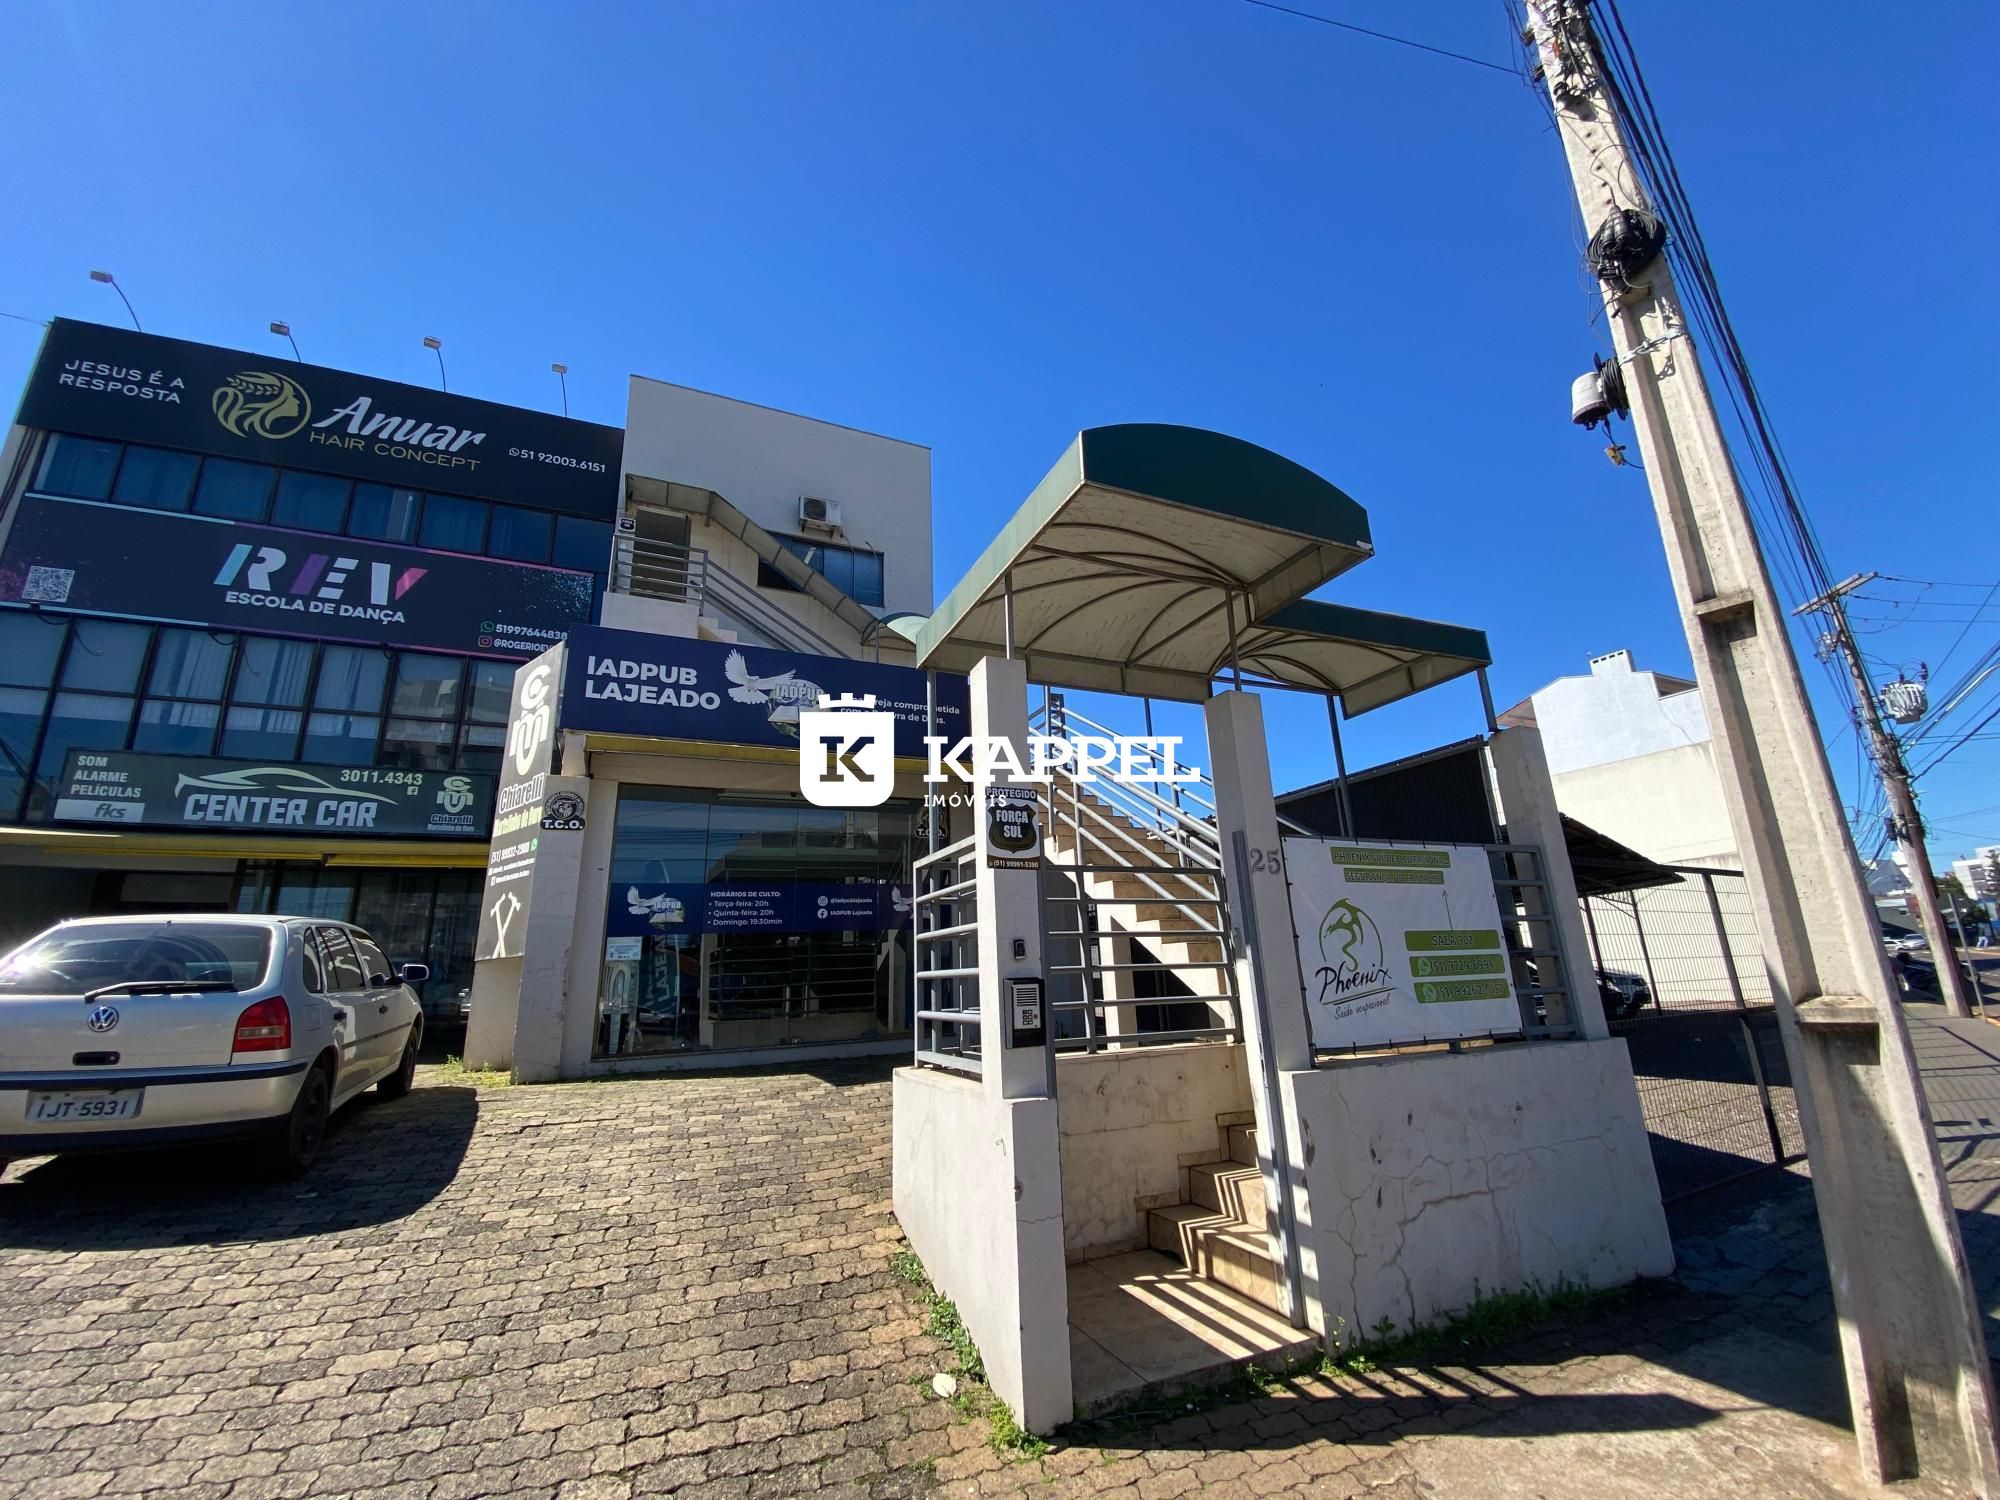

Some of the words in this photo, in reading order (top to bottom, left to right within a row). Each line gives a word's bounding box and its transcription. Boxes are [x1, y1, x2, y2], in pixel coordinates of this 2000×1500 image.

[65, 360, 143, 381] JESUS
[149, 370, 164, 385] É
[170, 377, 185, 389] A
[59, 373, 181, 404] RESPOSTA
[312, 396, 487, 453] Anuar
[310, 431, 365, 451] HAIR
[374, 443, 481, 472] CONCEPT
[520, 449, 534, 460] 51
[537, 452, 606, 473] 92003.6151
[213, 543, 428, 606] REV
[225, 590, 305, 612] ESCOLA
[309, 601, 335, 615] DE
[339, 605, 406, 625] DANÇA
[493, 639, 554, 652] @ROGERIOEV
[587, 655, 698, 686] IADPUB
[585, 680, 721, 710] LAJEADO
[894, 701, 960, 714] comproetida
[908, 713, 920, 721] de
[78, 755, 108, 767] SOM
[73, 770, 129, 783] ALARME
[340, 770, 423, 786] 3011.4343
[70, 784, 142, 798] PELÍCULAS
[498, 772, 546, 815] Chiarelli
[986, 787, 1037, 799] PROTEGIDO
[94, 803, 127, 819] fks
[183, 793, 309, 825] CENTER
[315, 800, 378, 828] CAR
[995, 809, 1029, 825] FORÇA
[543, 819, 584, 829] T.C.O.
[1003, 825, 1023, 838] SUL
[1250, 848, 1281, 875] 25
[714, 900, 754, 908] Terça-feira:
[713, 909, 759, 917] Quinta-feira:
[1432, 935, 1456, 946] SALA
[1315, 960, 1392, 1003] Phoenix
